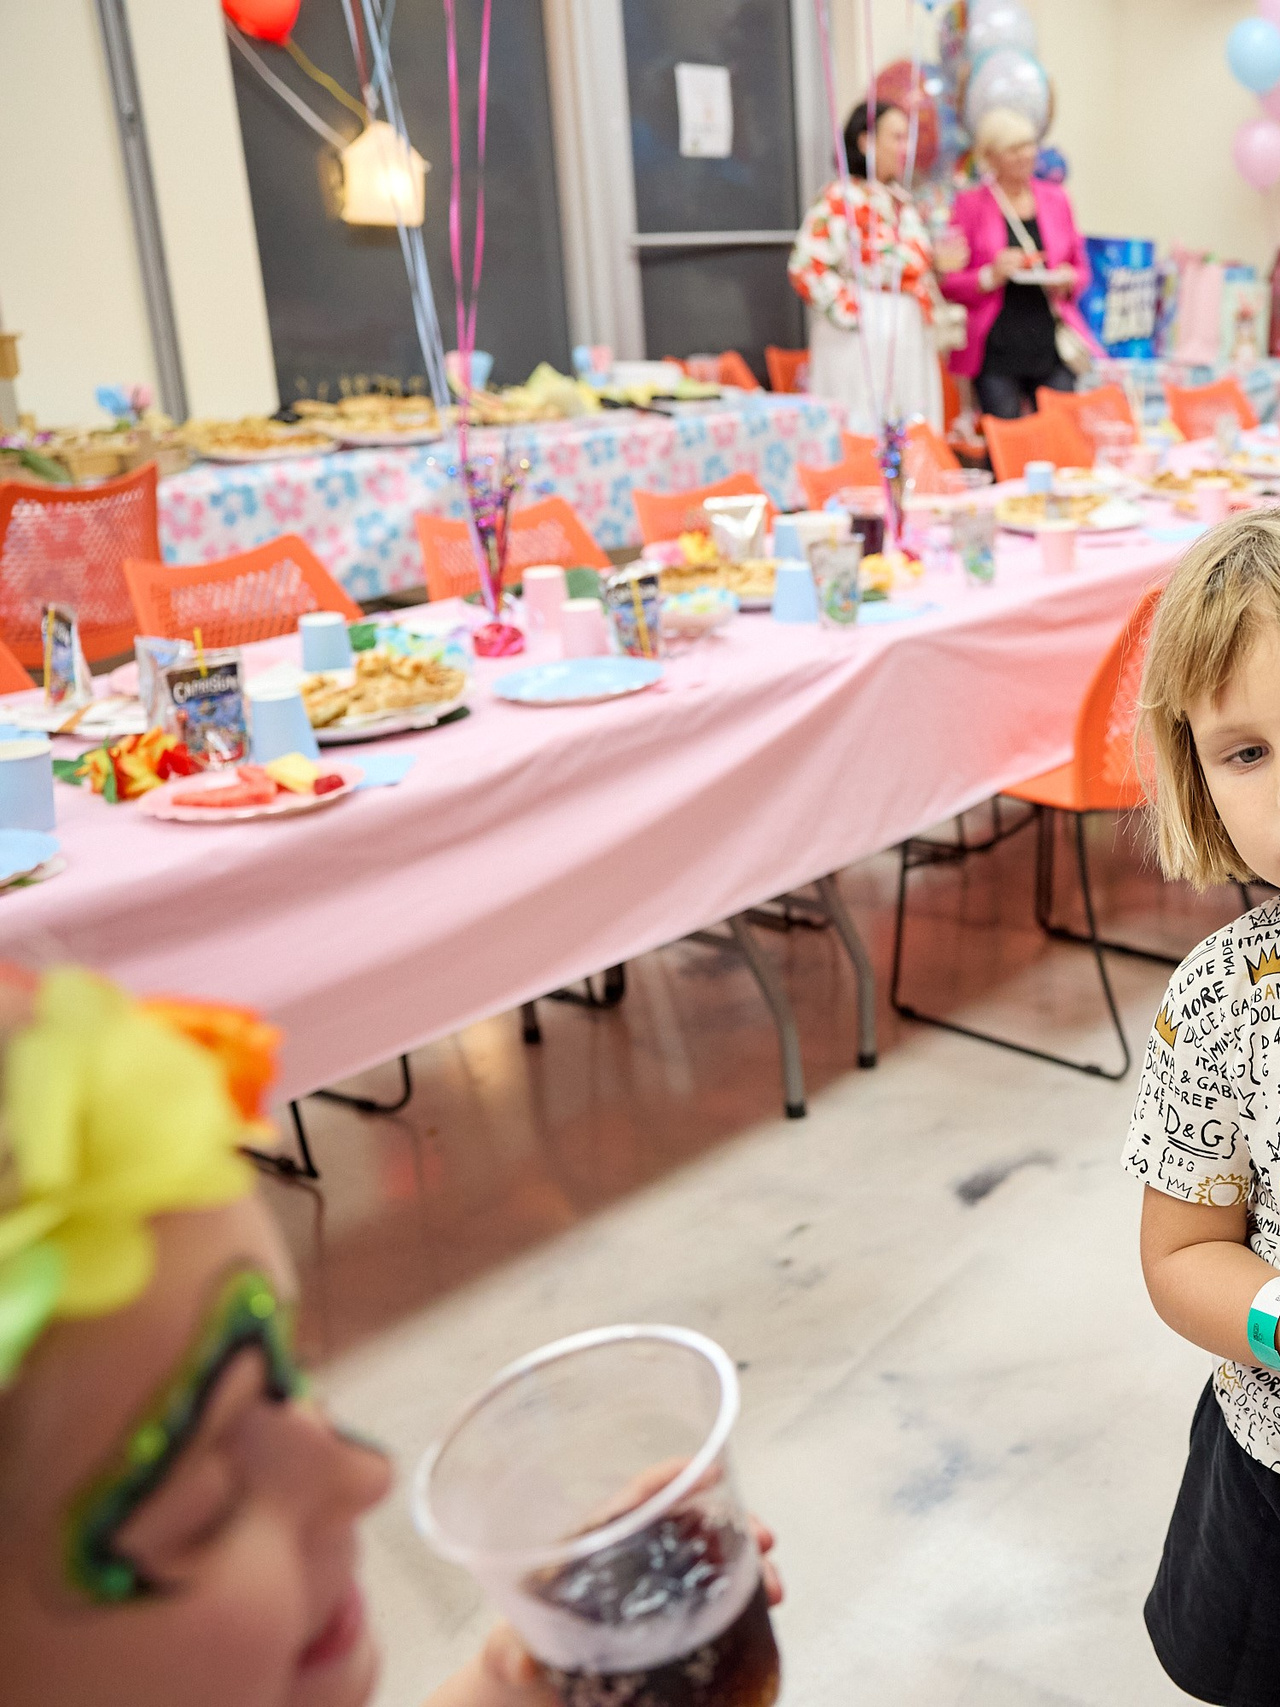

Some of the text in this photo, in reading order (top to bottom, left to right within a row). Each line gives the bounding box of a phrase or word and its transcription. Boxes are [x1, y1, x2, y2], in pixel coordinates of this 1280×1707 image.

[1222, 938, 1235, 976] MADE
[1179, 959, 1215, 994] LOVE
[1181, 1070, 1190, 1083] &
[1165, 1104, 1224, 1147] D&G
